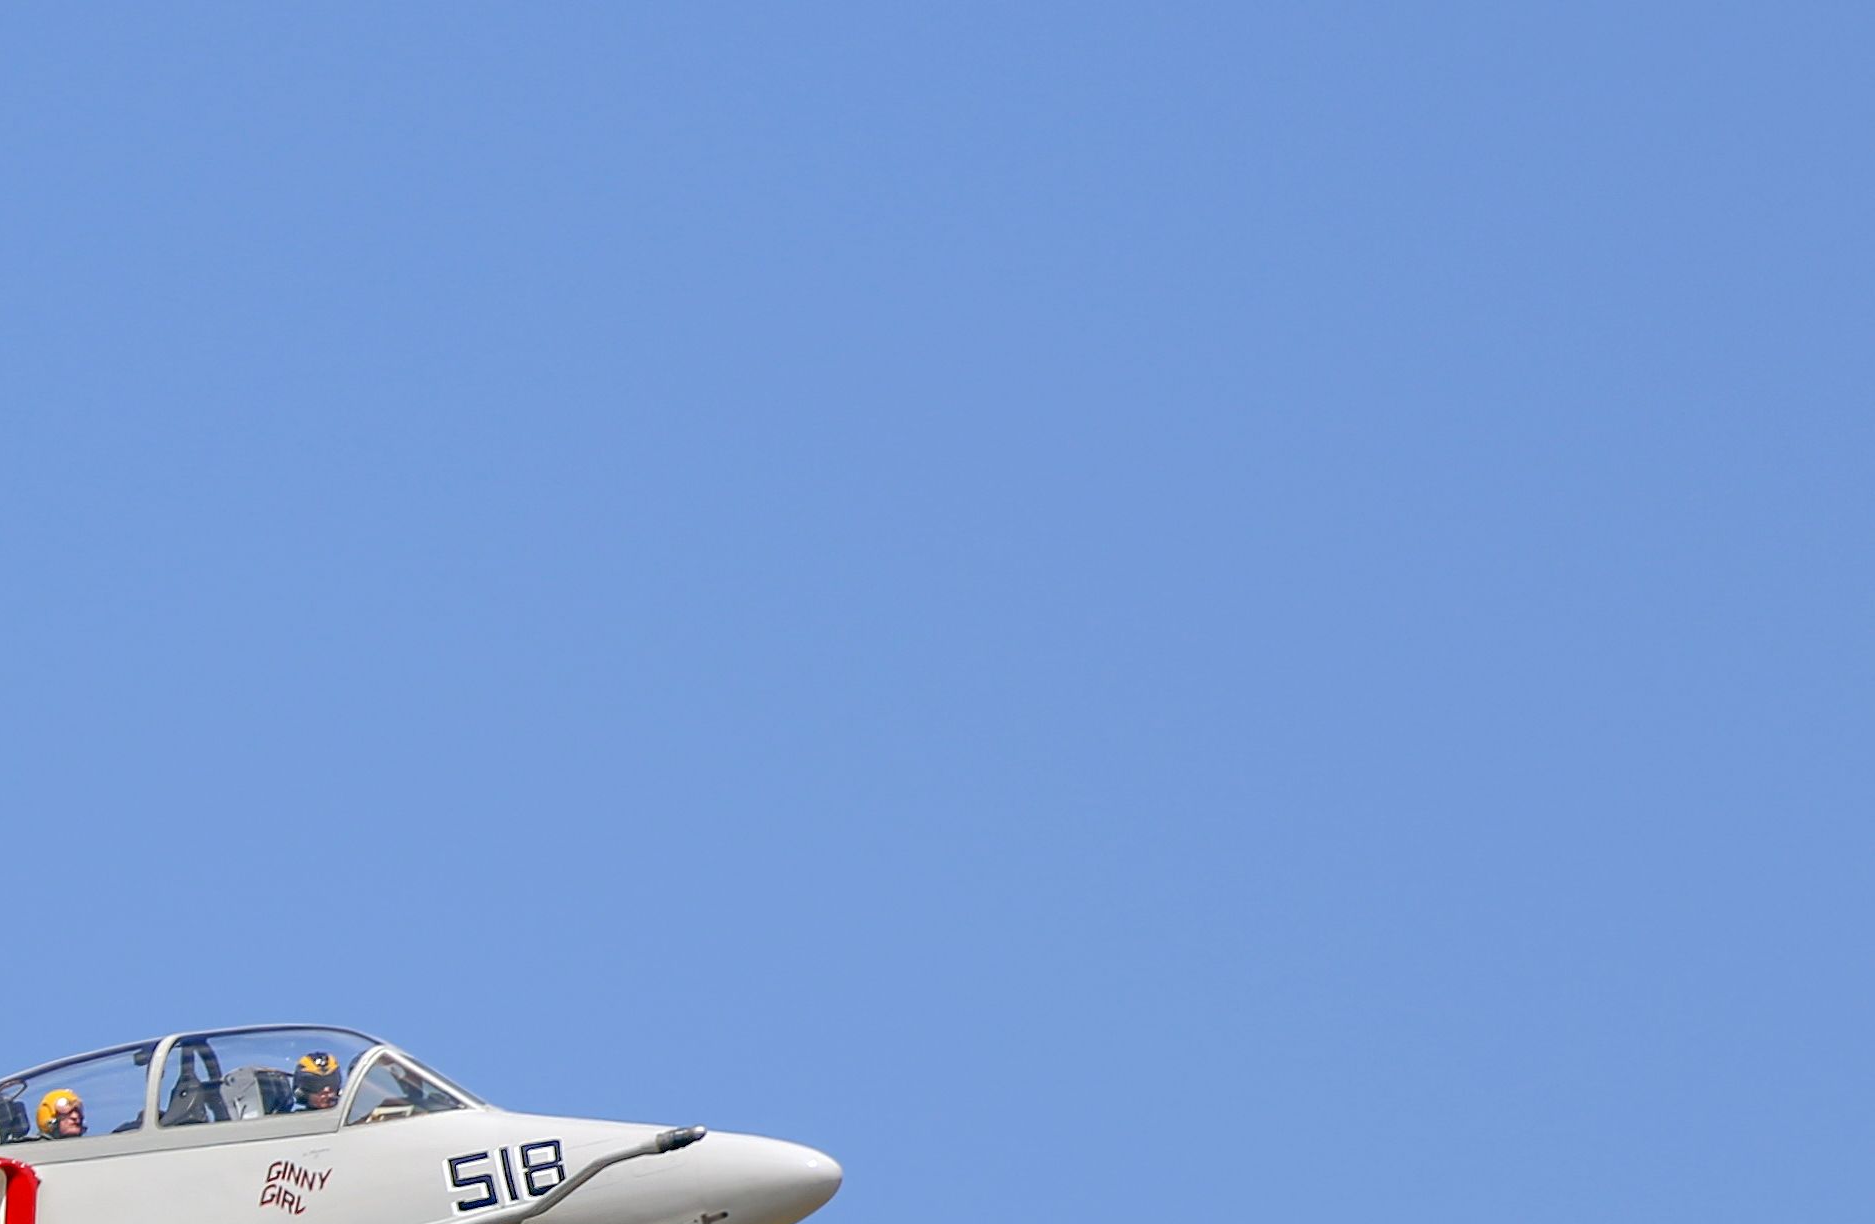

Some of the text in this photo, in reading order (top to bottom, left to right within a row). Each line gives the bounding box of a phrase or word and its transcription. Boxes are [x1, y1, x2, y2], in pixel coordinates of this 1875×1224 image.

[266, 1161, 333, 1191] GINNY
[448, 1140, 565, 1211] 518
[260, 1184, 306, 1215] GIRL
